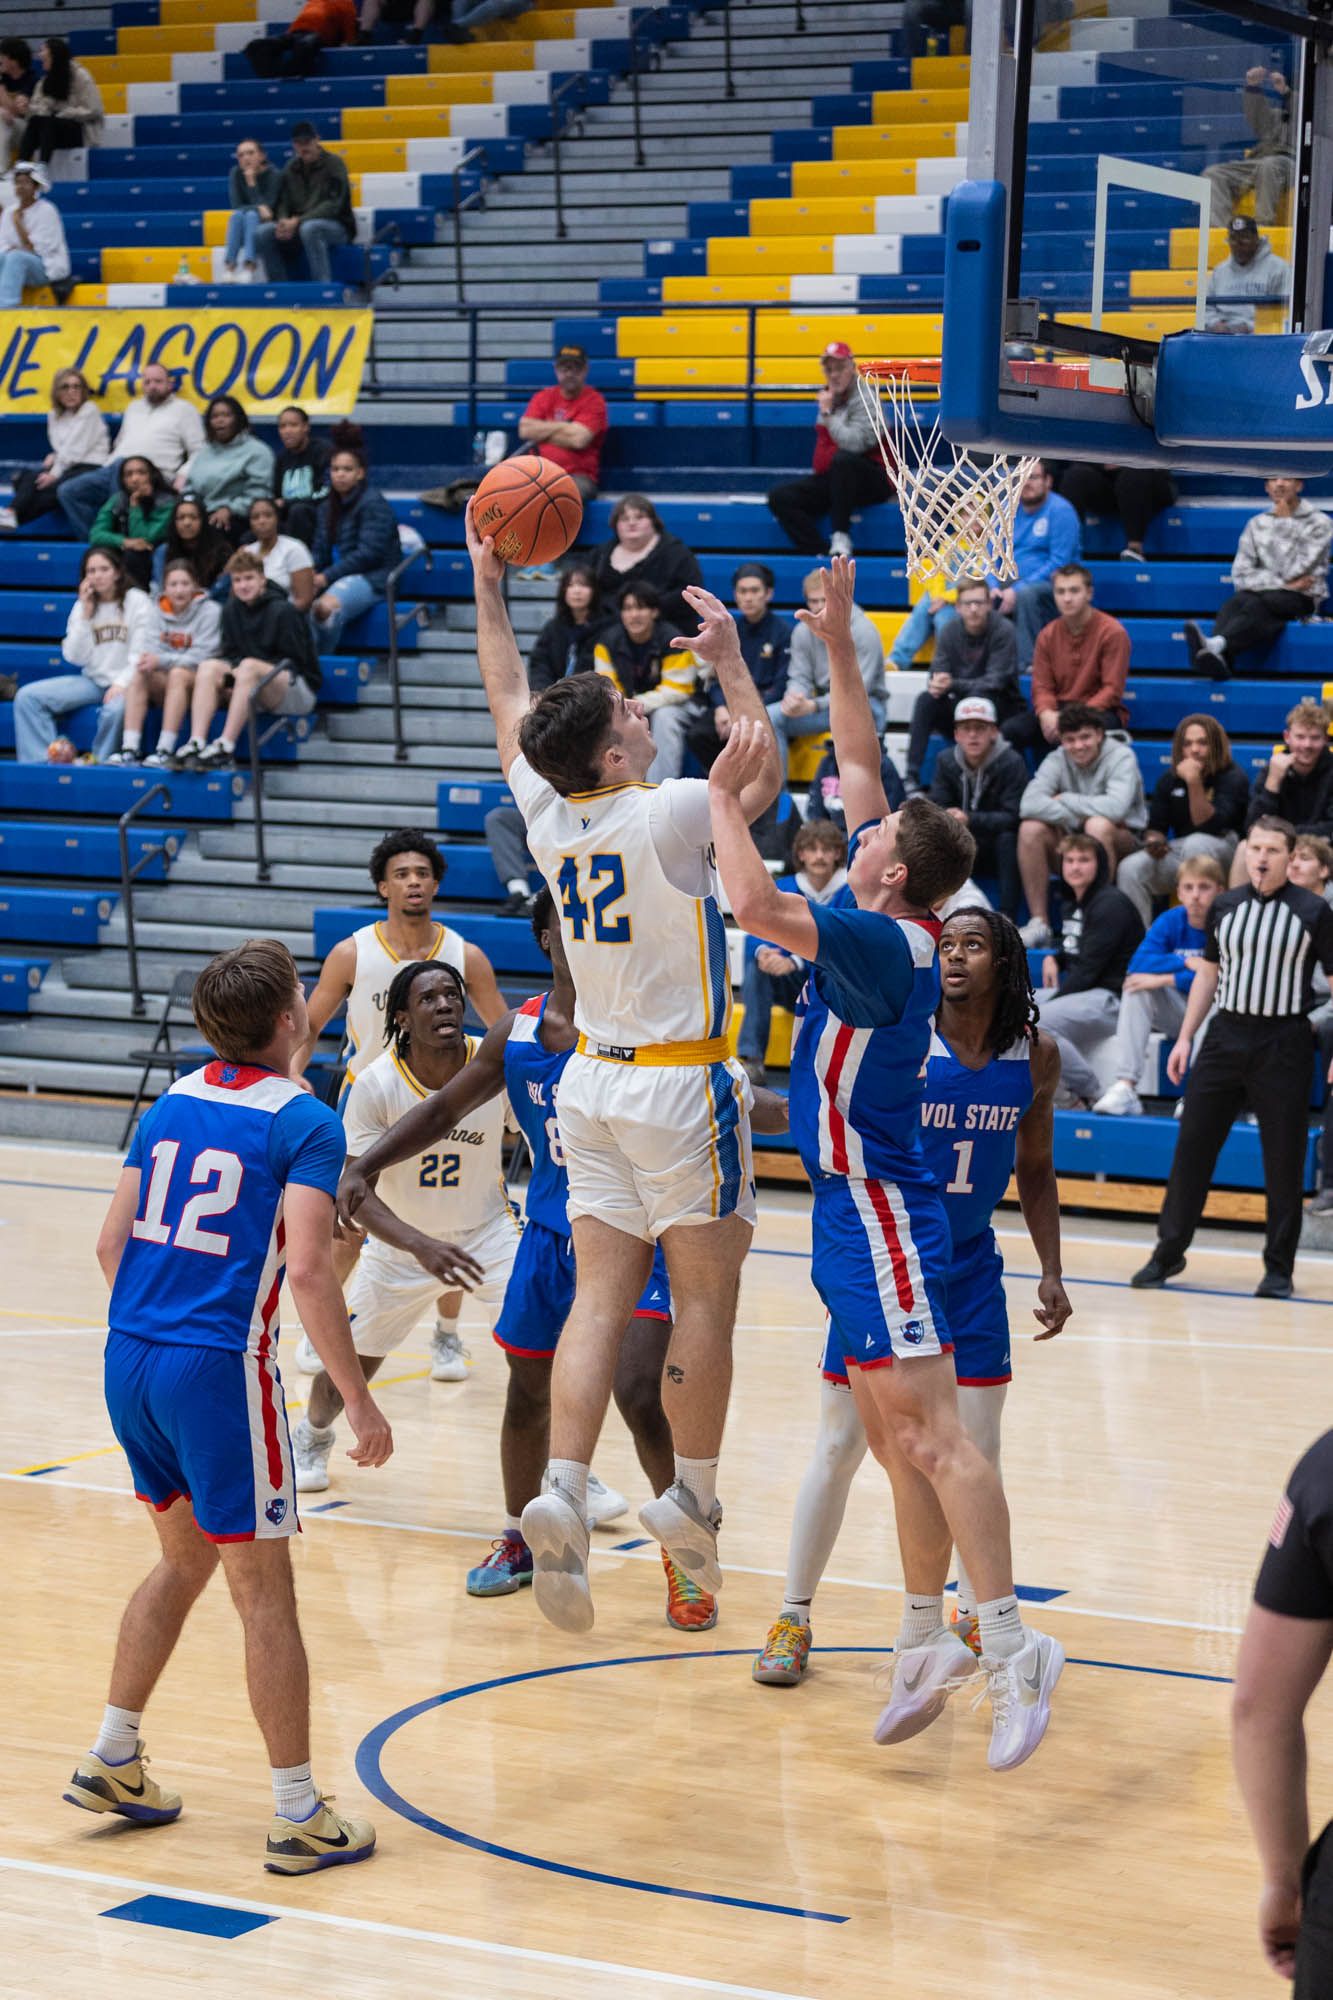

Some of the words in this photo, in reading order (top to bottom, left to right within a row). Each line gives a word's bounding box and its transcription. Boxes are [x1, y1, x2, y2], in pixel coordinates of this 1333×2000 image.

[1296, 353, 1333, 410] S
[557, 852, 633, 945] 42
[921, 1102, 956, 1129] VOL
[964, 1104, 1020, 1131] STATE
[419, 1153, 461, 1188] 22
[946, 1140, 974, 1194] 1
[131, 1139, 244, 1257] 12
